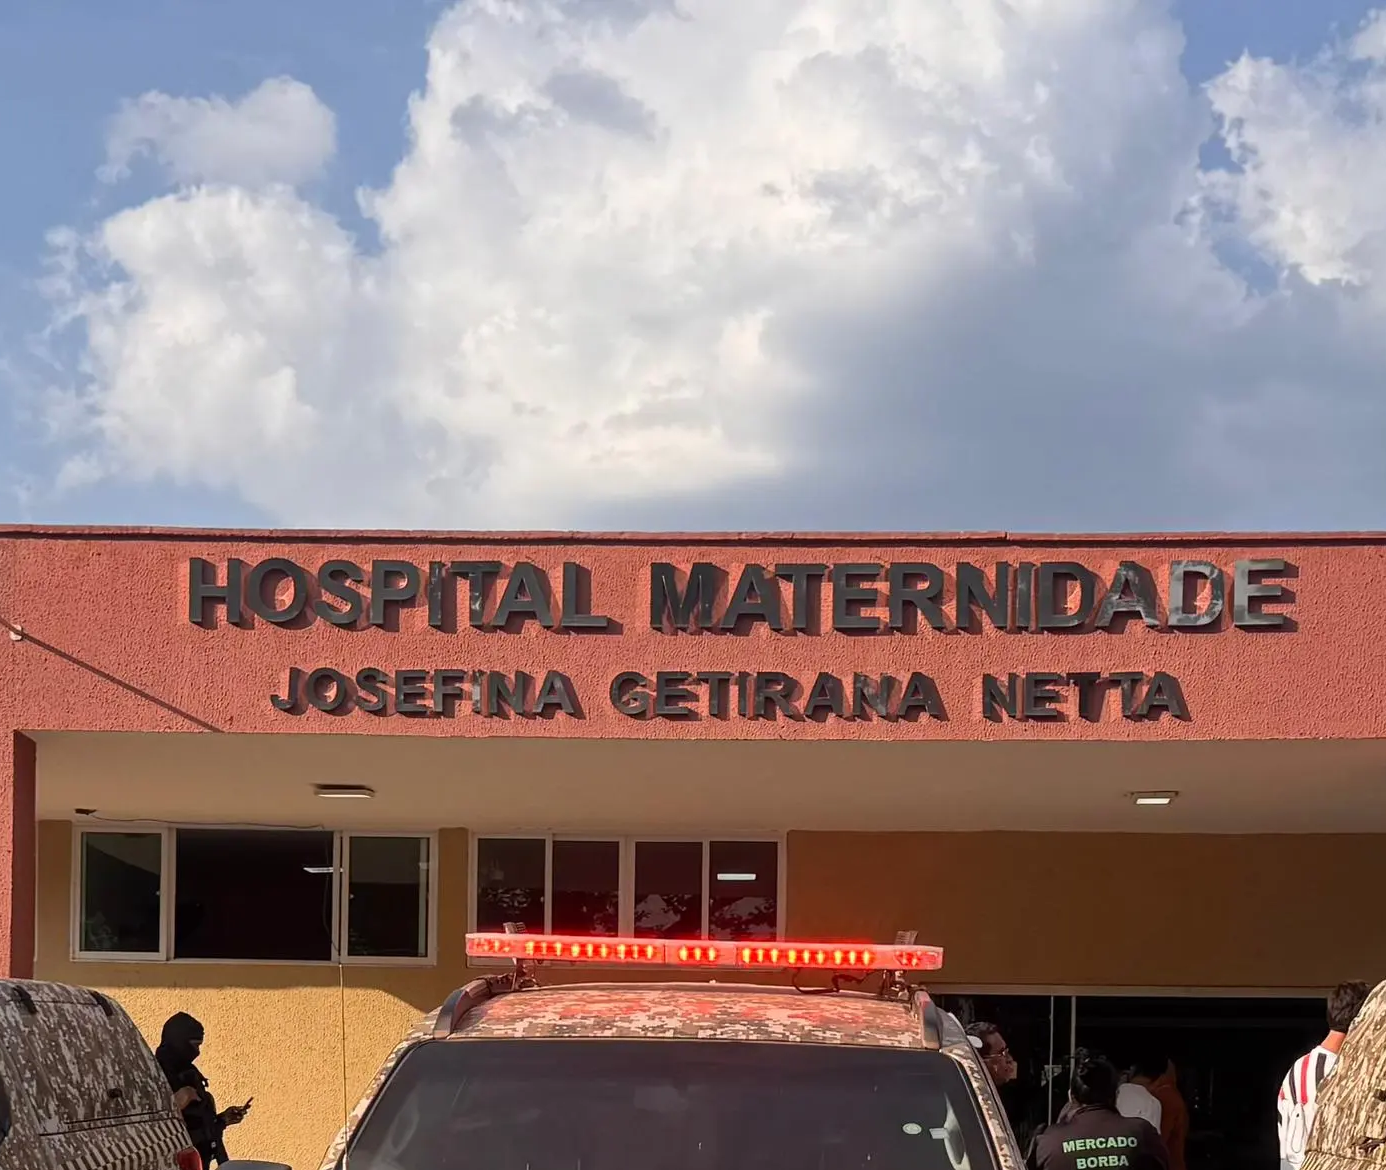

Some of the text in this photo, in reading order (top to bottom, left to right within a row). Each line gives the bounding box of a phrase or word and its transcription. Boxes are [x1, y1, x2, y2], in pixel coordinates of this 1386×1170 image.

[189, 557, 1287, 630] HOSPITAL MATERNIDADE
[269, 667, 1185, 718] JOSEFINA GETIRANA NETTA
[1062, 1136, 1138, 1153] MERCADO
[1076, 1155, 1129, 1170] BORBA
